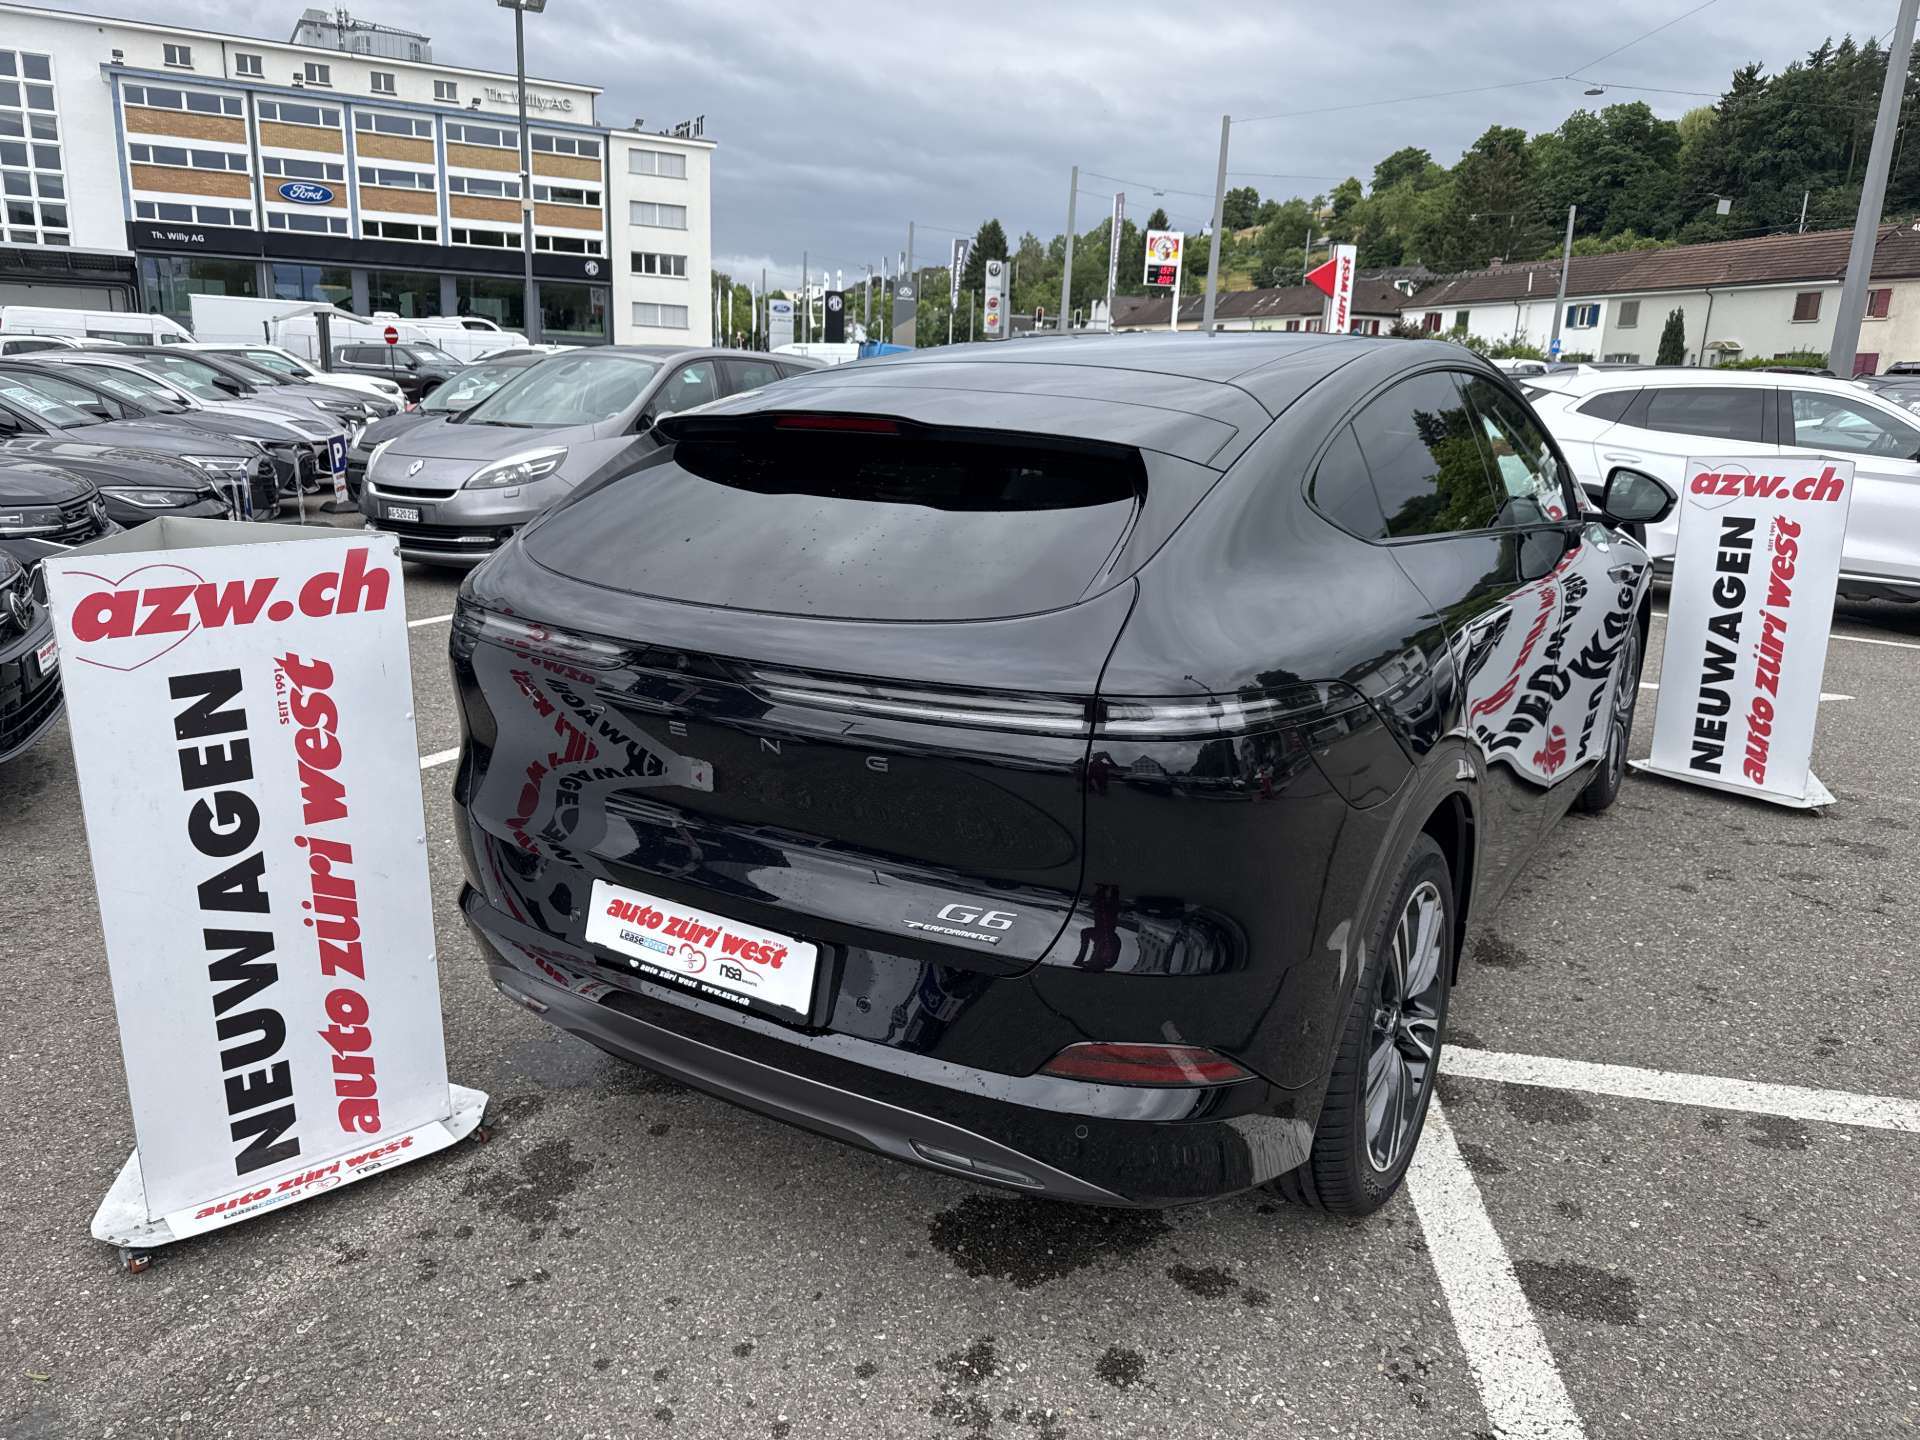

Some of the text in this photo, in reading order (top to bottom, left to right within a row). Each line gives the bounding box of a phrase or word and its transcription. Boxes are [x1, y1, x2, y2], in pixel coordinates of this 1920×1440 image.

[551, 98, 573, 112] AG
[290, 183, 323, 200] Ford
[151, 230, 205, 243] Th. Willy AG
[585, 261, 599, 276] MG
[1341, 256, 1351, 292] west
[828, 296, 843, 311] MG
[332, 442, 343, 468] P
[1690, 467, 1845, 502] azw.ch
[71, 548, 390, 642] azw.ch
[1690, 516, 1756, 774] NEUWAGEN
[1743, 515, 1801, 785] auto züri west
[274, 668, 290, 725] SEIT 1991
[272, 652, 381, 1134] auto züri west
[168, 668, 301, 1176] NEUWAGEN
[607, 899, 789, 969] auto züri west
[903, 919, 1000, 943] PERFORMANCE
[937, 903, 1018, 930] G6
[639, 963, 751, 1006] auto züri west www.azw.ch
[719, 964, 742, 982] nsa
[194, 1136, 414, 1219] auto züri west
[356, 1162, 383, 1175] nsa
